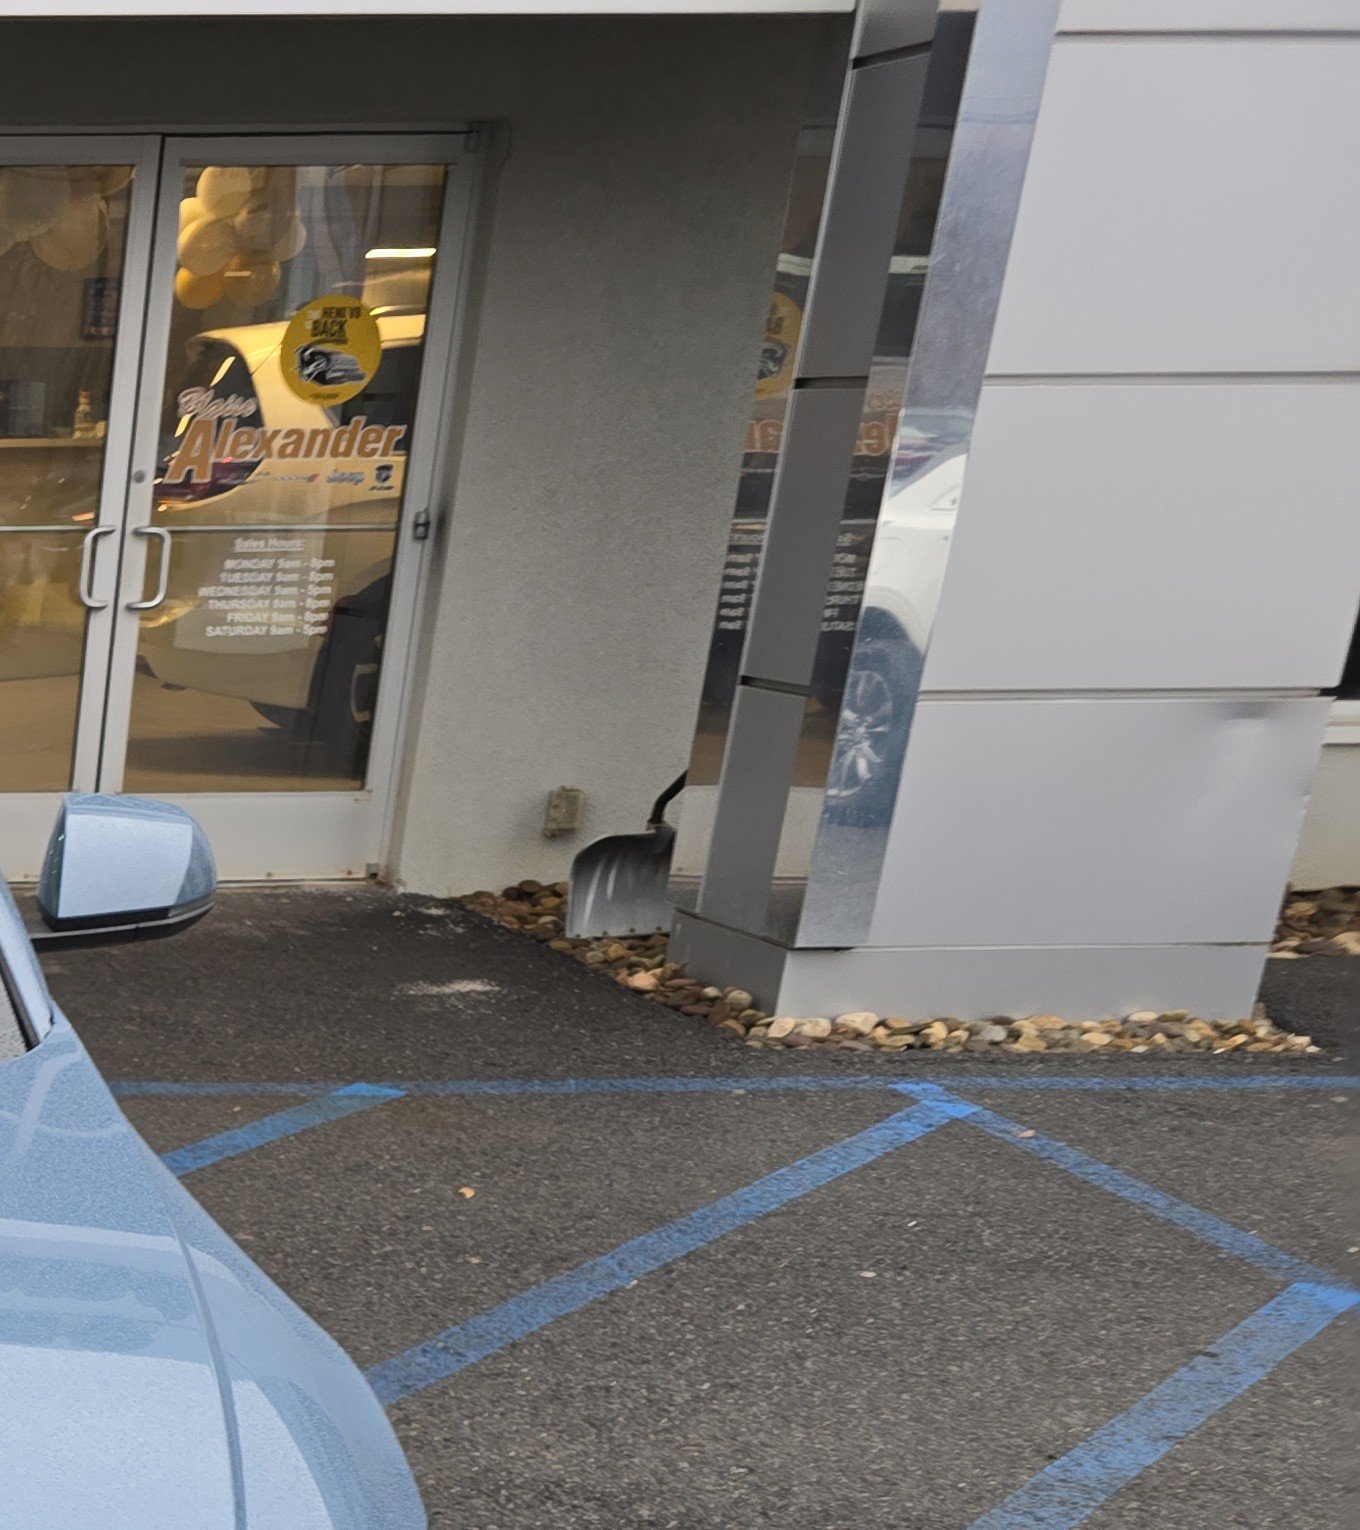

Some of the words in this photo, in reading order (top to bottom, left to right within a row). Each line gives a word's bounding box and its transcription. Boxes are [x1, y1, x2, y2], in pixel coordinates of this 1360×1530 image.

[311, 320, 348, 337] BACK
[164, 415, 408, 484] Alexander
[205, 625, 268, 637] SATURDAY
